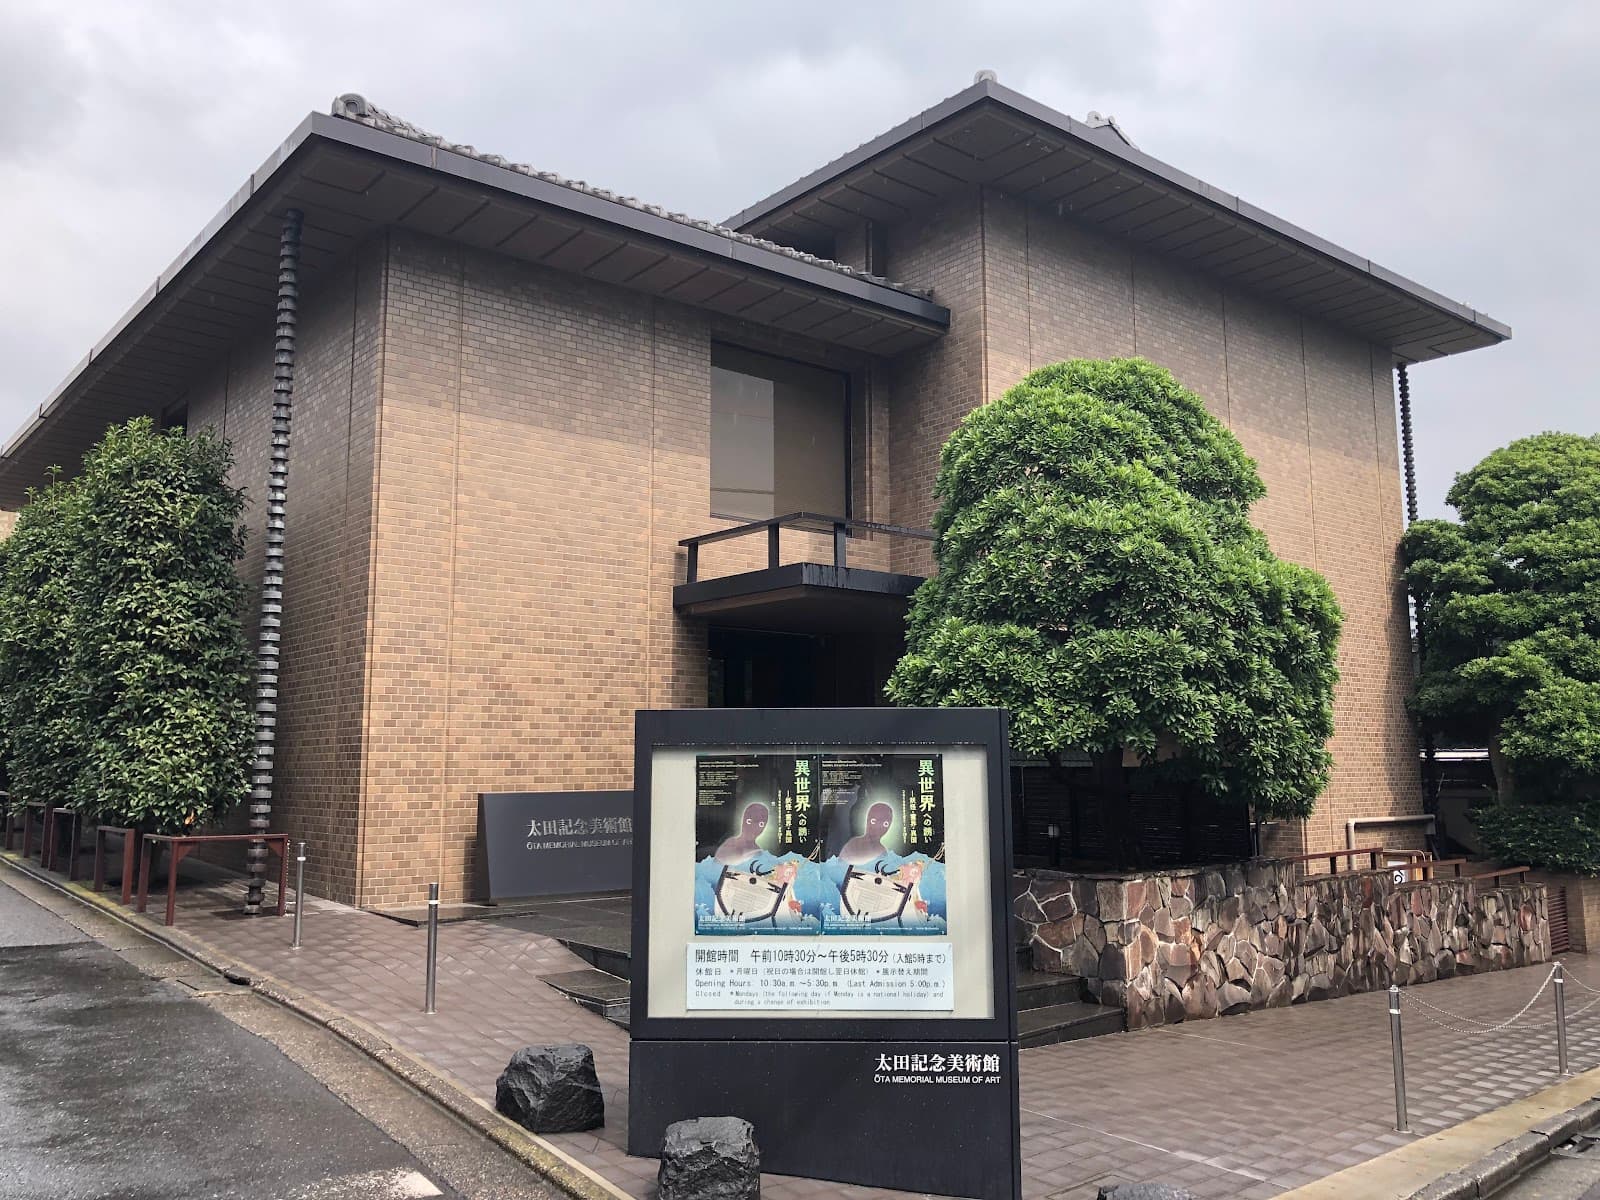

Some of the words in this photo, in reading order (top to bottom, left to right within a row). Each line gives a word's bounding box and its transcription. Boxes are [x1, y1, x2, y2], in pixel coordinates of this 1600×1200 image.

[526, 816, 633, 837] 太田記念美術館
[695, 949, 739, 963] 開館時間
[695, 967, 721, 976] 休館日
[695, 979, 726, 988] Opening
[730, 979, 751, 987] Hours
[870, 979, 906, 988] Admission
[874, 1053, 1001, 1073] 太田記念美術館
[892, 1075, 934, 1084] MEMORIAL
[935, 1075, 970, 1084] MUSEUM
[972, 1075, 983, 1084] OF
[984, 1076, 1001, 1084] ART
